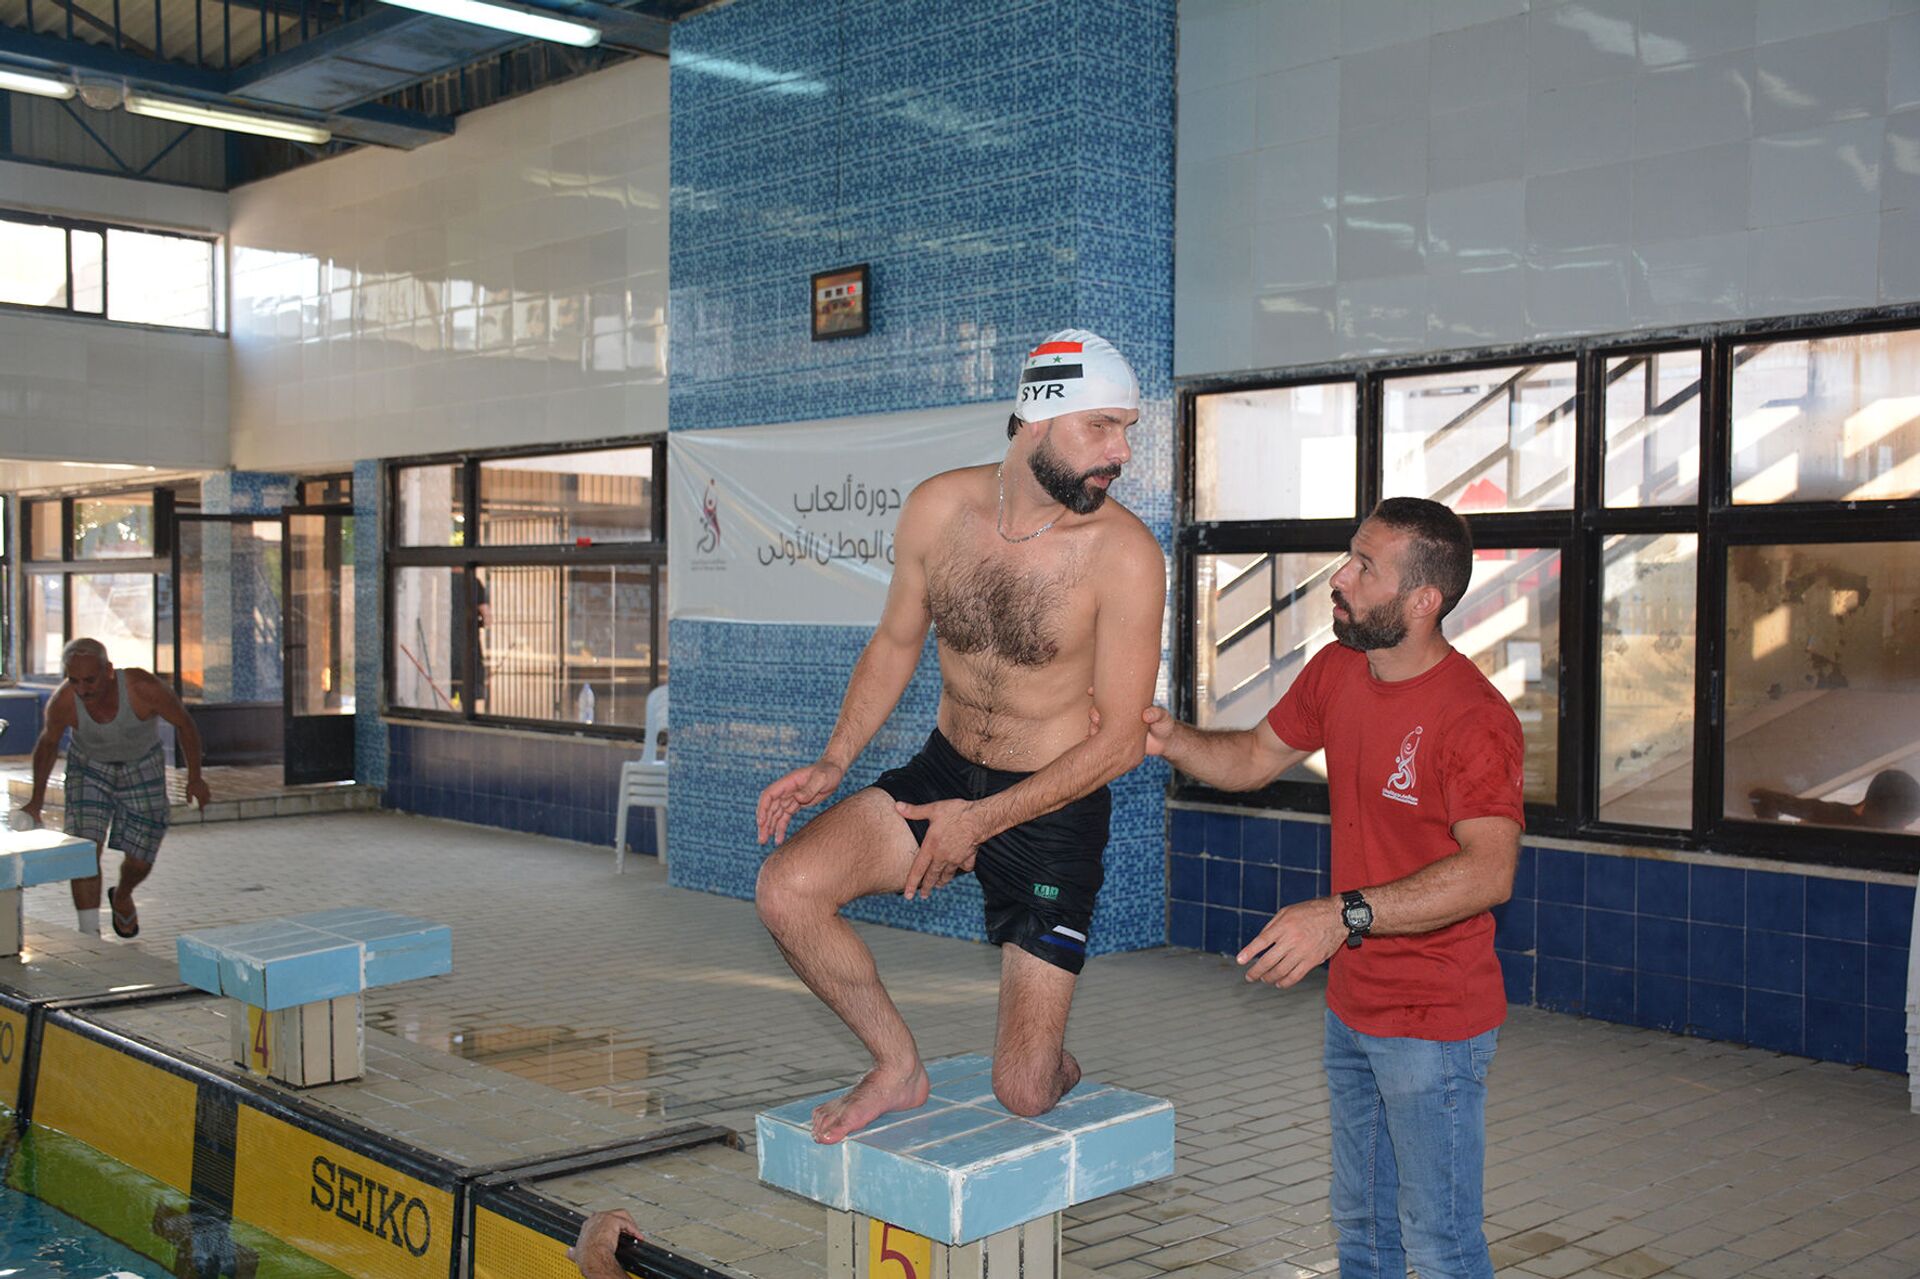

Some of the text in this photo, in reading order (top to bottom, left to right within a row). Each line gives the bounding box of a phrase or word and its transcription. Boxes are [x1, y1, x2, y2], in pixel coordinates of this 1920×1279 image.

[1022, 383, 1065, 401] SYR
[793, 474, 900, 518] دورة ألعاب
[758, 525, 815, 565] الأولى
[816, 529, 884, 565] الوطن
[254, 1009, 269, 1068] 4
[311, 1155, 431, 1257] SEIKO
[880, 1222, 917, 1279] 5
